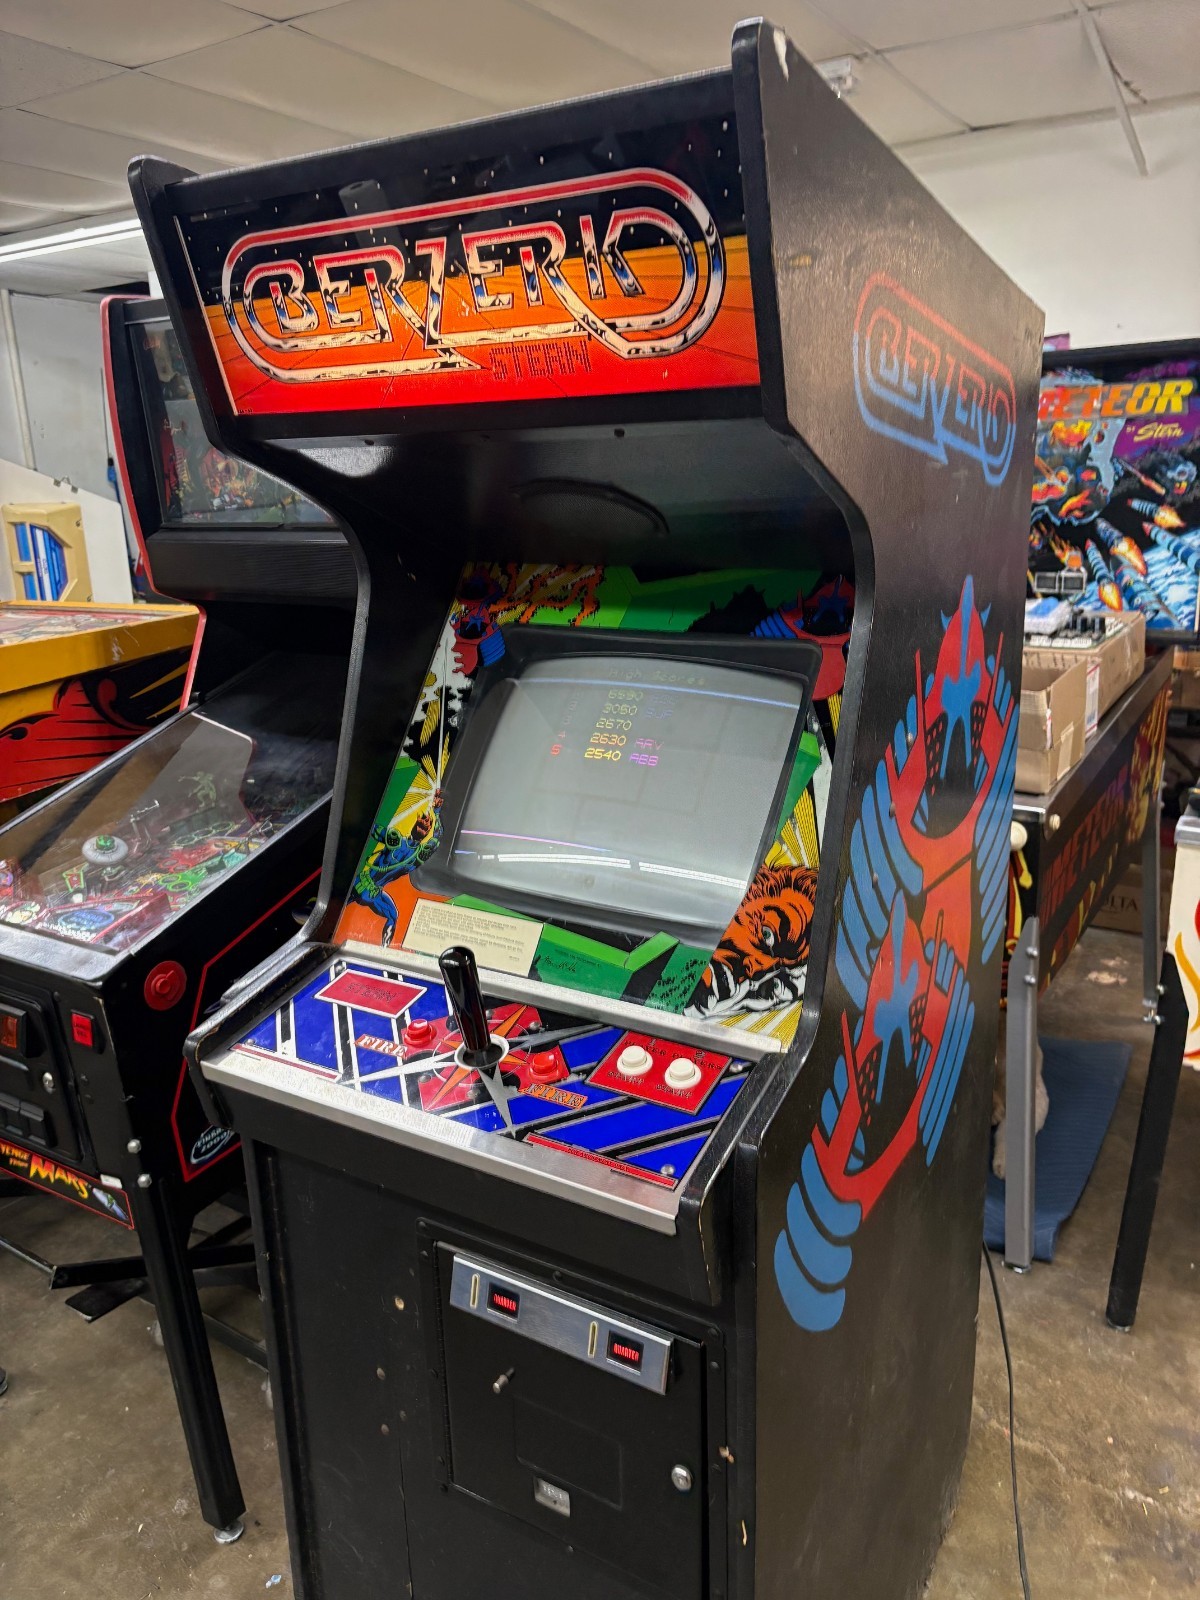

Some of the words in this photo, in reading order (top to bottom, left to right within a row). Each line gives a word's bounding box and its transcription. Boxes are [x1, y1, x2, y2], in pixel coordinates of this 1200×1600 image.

[228, 182, 717, 379] BERZERK
[489, 341, 591, 380] STERN
[854, 278, 1016, 480] BERZERK
[1133, 422, 1184, 442] Stern
[596, 718, 632, 731] 2670
[590, 732, 627, 746] 2630
[584, 747, 622, 761] 2540
[358, 1035, 408, 1058] FIRE
[525, 1083, 585, 1108] FIRE
[29, 1154, 90, 1199] MARS
[613, 1343, 640, 1361] QUARTER
